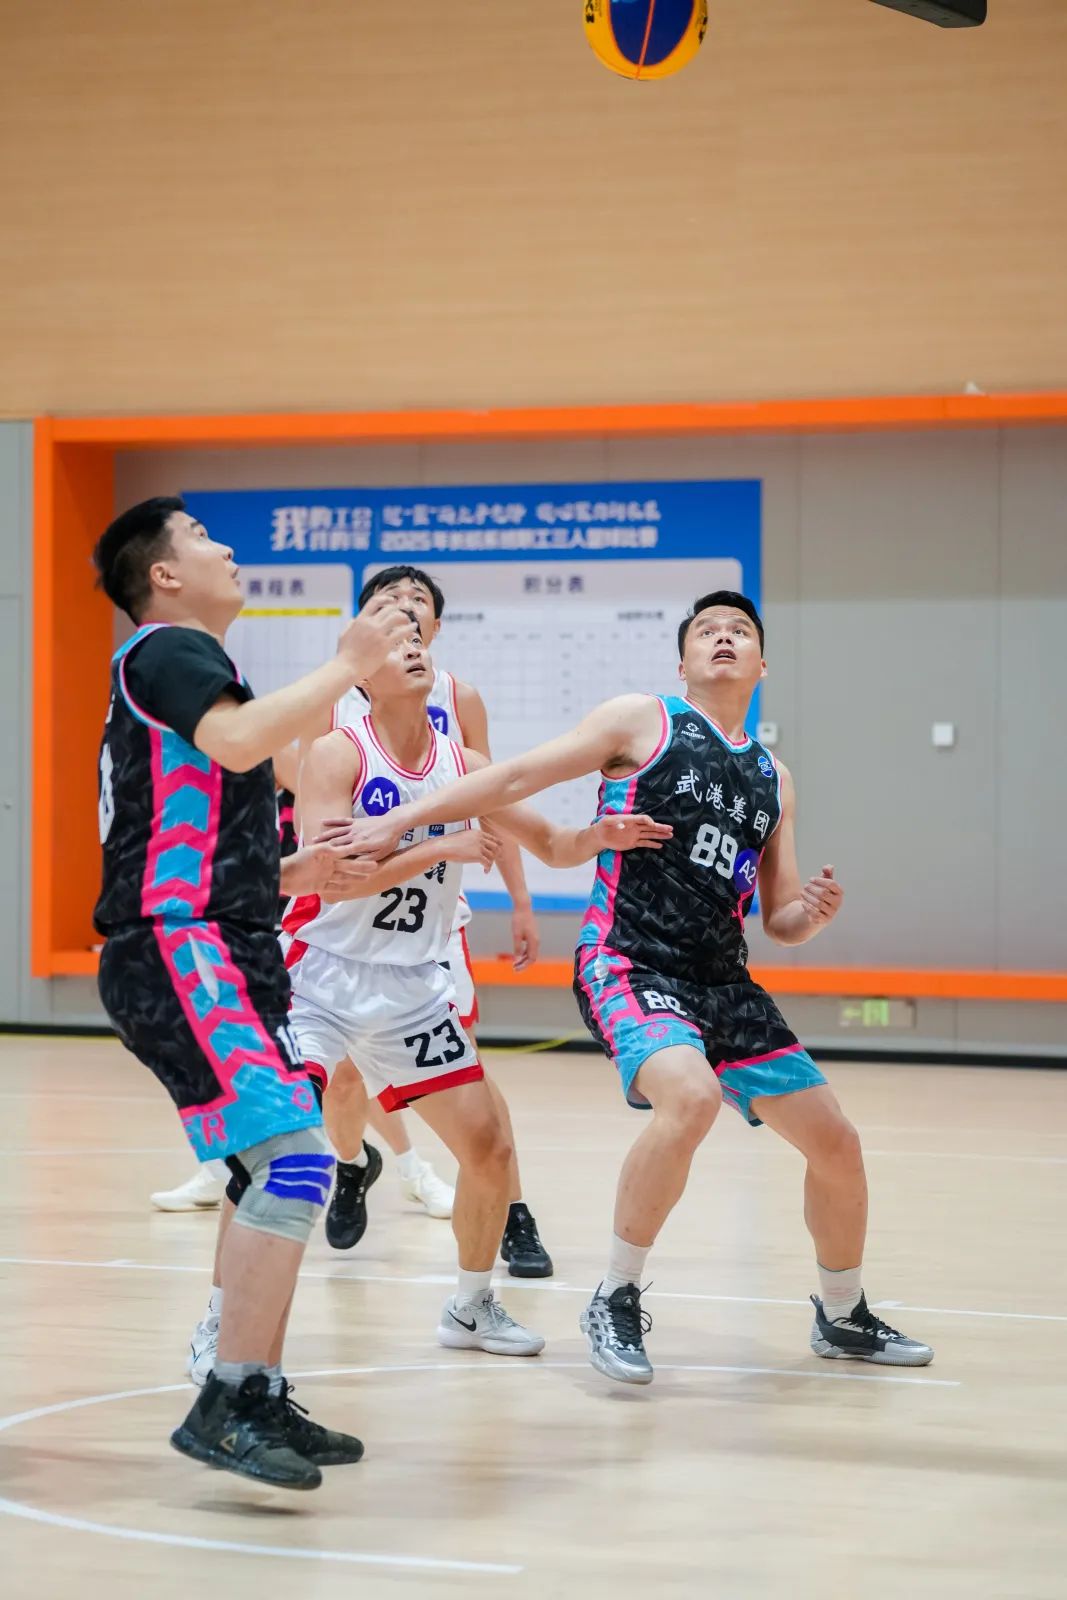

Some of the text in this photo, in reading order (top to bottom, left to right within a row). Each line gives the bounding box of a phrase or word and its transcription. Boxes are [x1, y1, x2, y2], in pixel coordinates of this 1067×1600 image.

[367, 788, 394, 810] A1
[675, 769, 770, 839] 武港集团
[689, 823, 739, 880] 89
[738, 859, 757, 885] A2
[372, 886, 428, 933] 23
[404, 1018, 466, 1068] 23
